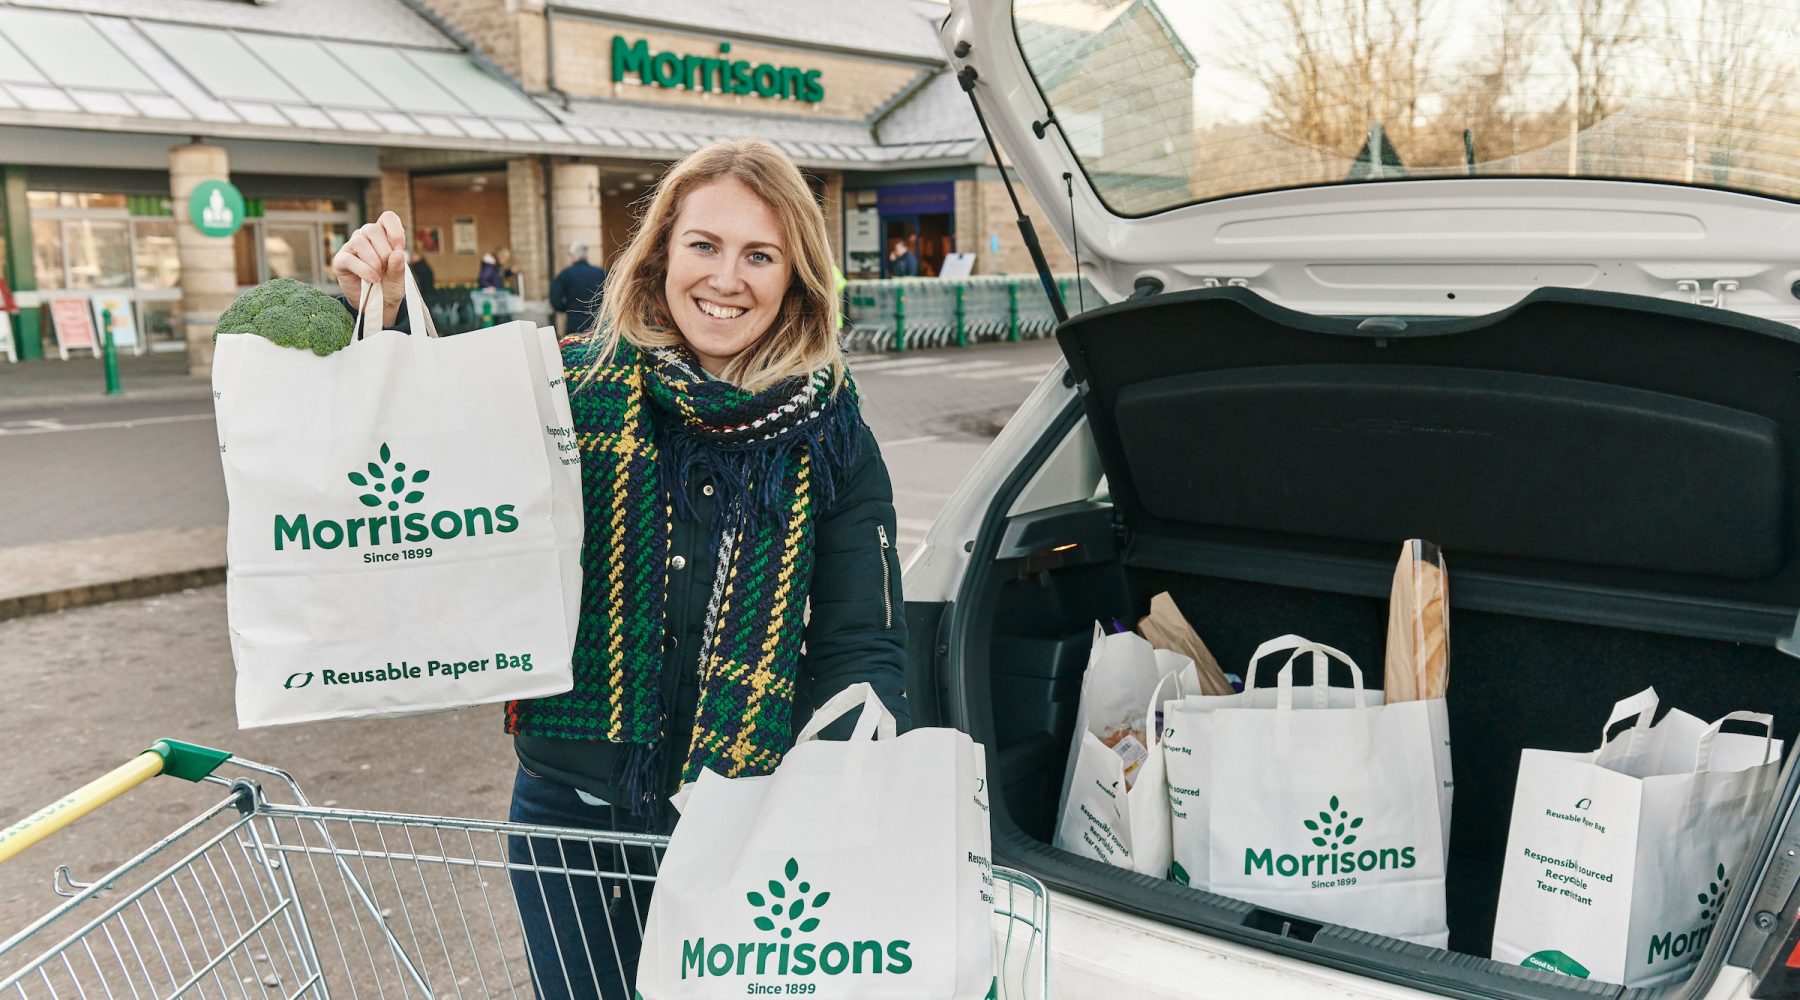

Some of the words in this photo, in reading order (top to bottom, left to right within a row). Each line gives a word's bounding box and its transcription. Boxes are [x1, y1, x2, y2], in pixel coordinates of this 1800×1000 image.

[611, 35, 825, 103] Morrisons
[274, 501, 519, 550] Morrisons
[363, 552, 400, 563] Since
[401, 547, 433, 560] 1899
[323, 661, 422, 686] Reusable
[427, 658, 490, 681] Paper
[495, 652, 534, 672] Bag
[1173, 785, 1200, 797] sourced
[1546, 808, 1581, 823] Reusable
[1594, 822, 1606, 834] Bag
[1081, 804, 1112, 837] Responsibly
[1111, 834, 1129, 857] sourced
[1083, 831, 1095, 846] Tear
[1244, 843, 1417, 877] Morrisons
[1311, 880, 1336, 889] Since
[1336, 877, 1357, 887] 1899
[1578, 865, 1613, 883] sourced
[1536, 880, 1557, 893] Tear
[681, 927, 913, 979] Morrisons
[1529, 956, 1547, 968] Good
[747, 982, 782, 995] Since
[784, 983, 817, 995] 1899
